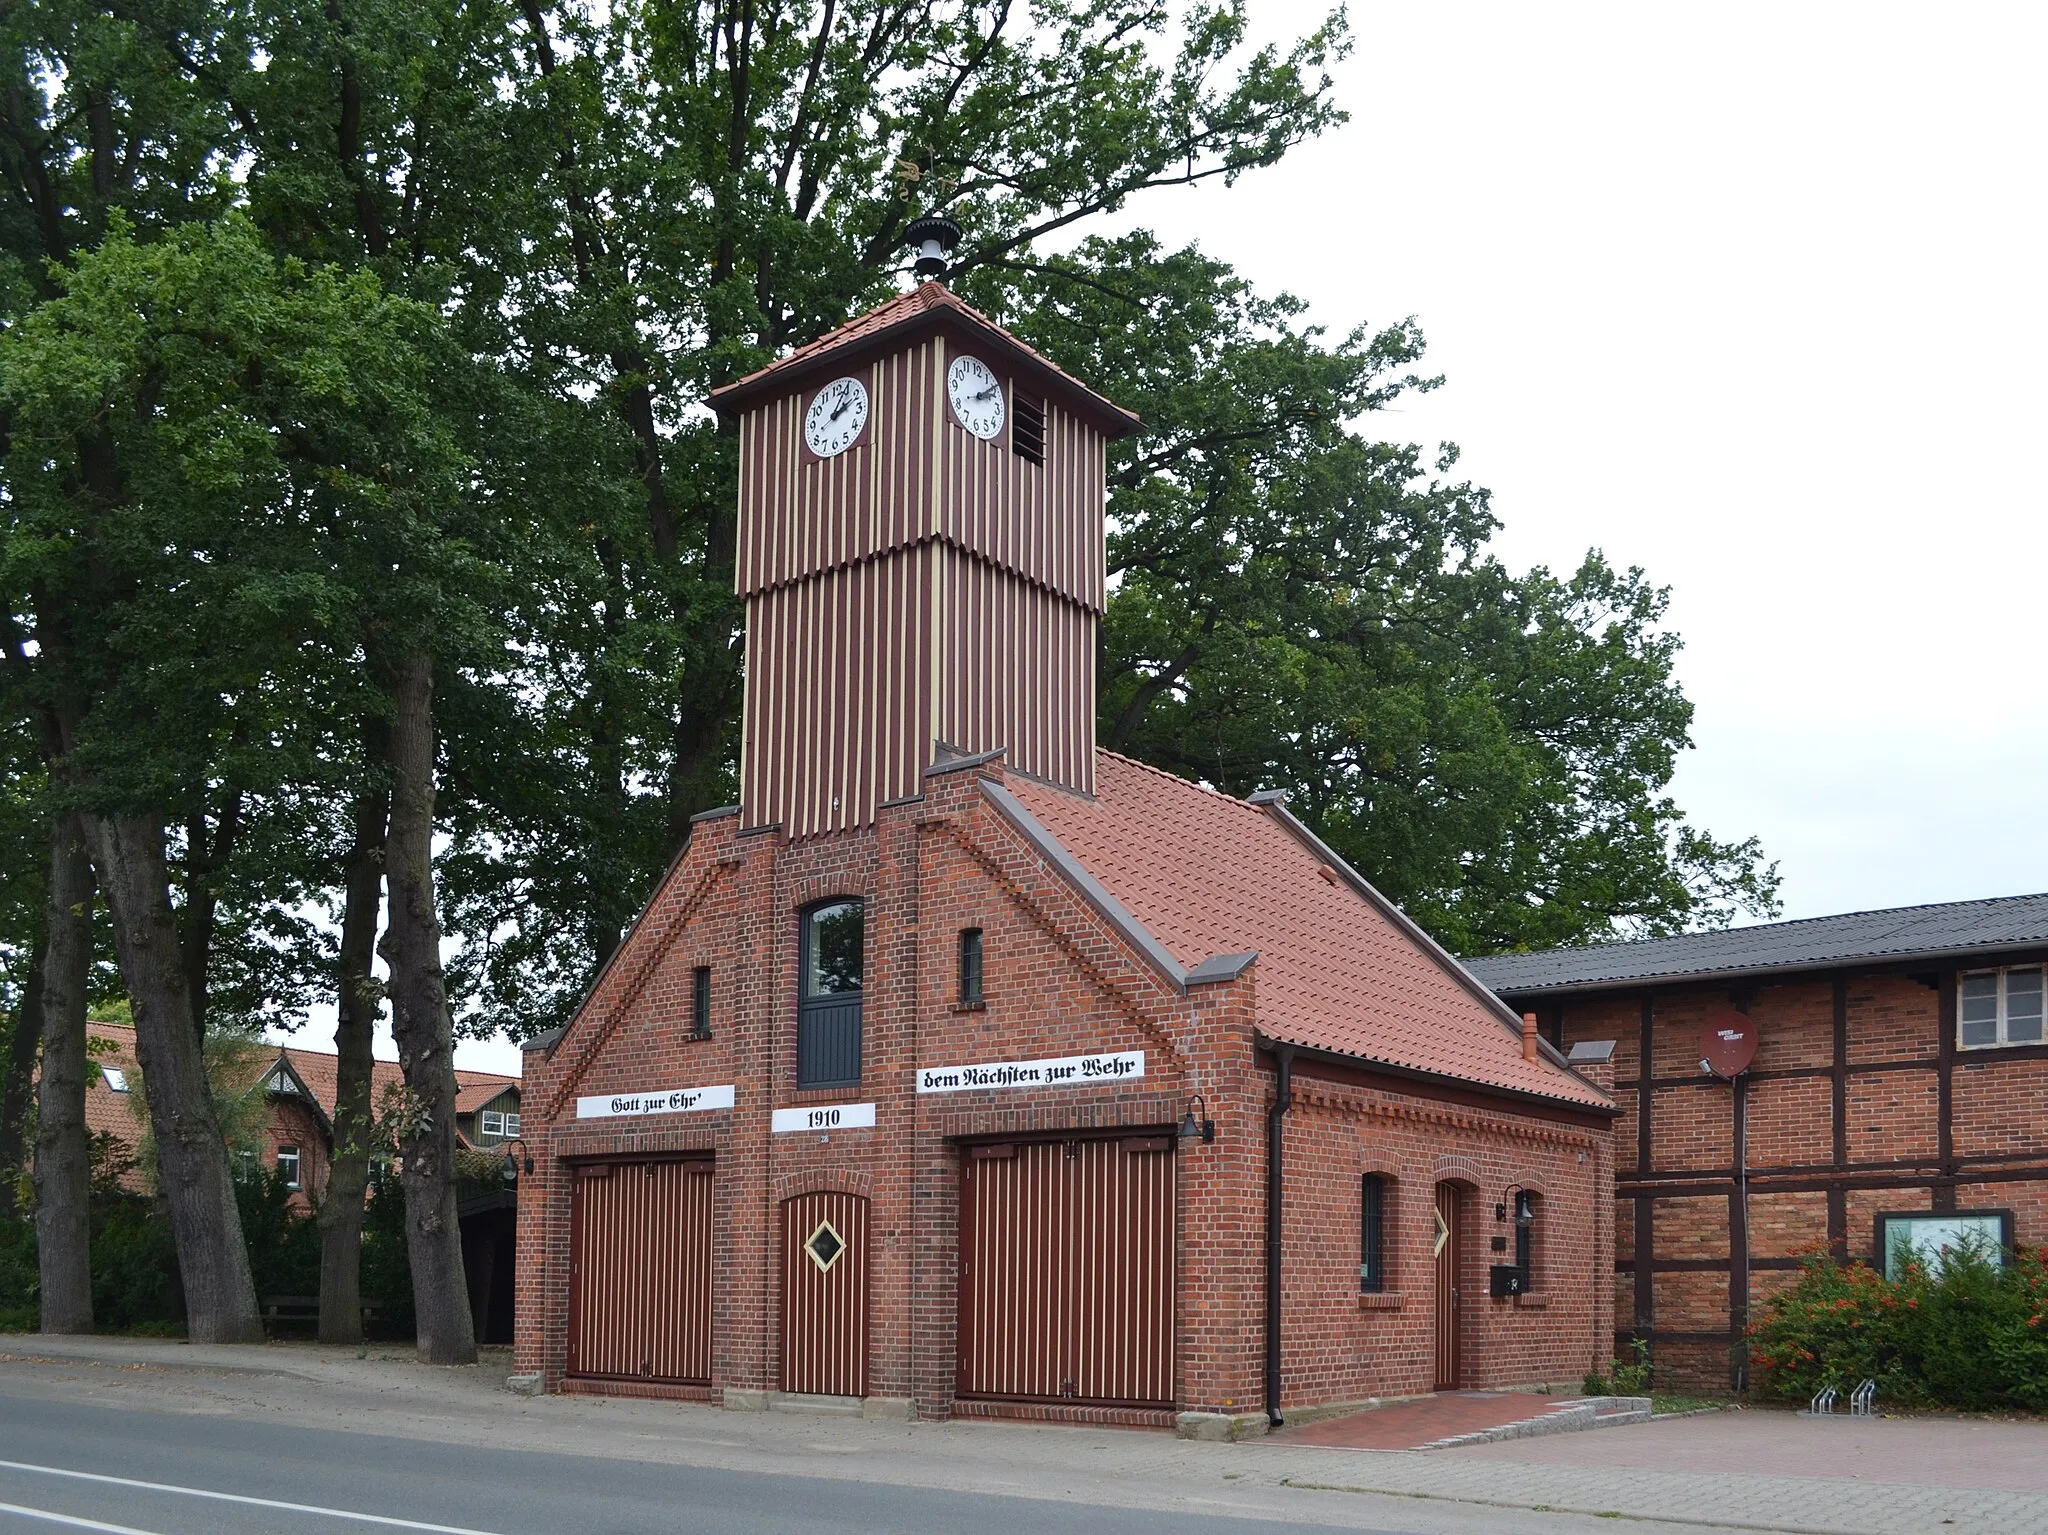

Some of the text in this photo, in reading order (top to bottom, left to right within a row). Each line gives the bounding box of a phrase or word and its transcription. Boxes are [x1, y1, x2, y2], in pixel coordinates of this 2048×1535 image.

[963, 360, 970, 373] 11
[973, 363, 982, 378] 12
[955, 367, 965, 381] 10
[832, 384, 842, 397] 12
[822, 392, 829, 405] 11
[811, 405, 823, 418] 10
[924, 1072, 960, 1088] dem
[1045, 1066, 1076, 1083] zur
[1081, 1057, 1136, 1077] Wehr
[611, 1098, 640, 1113] Gott
[643, 1100, 665, 1113] zur
[807, 1109, 840, 1128] 1910
